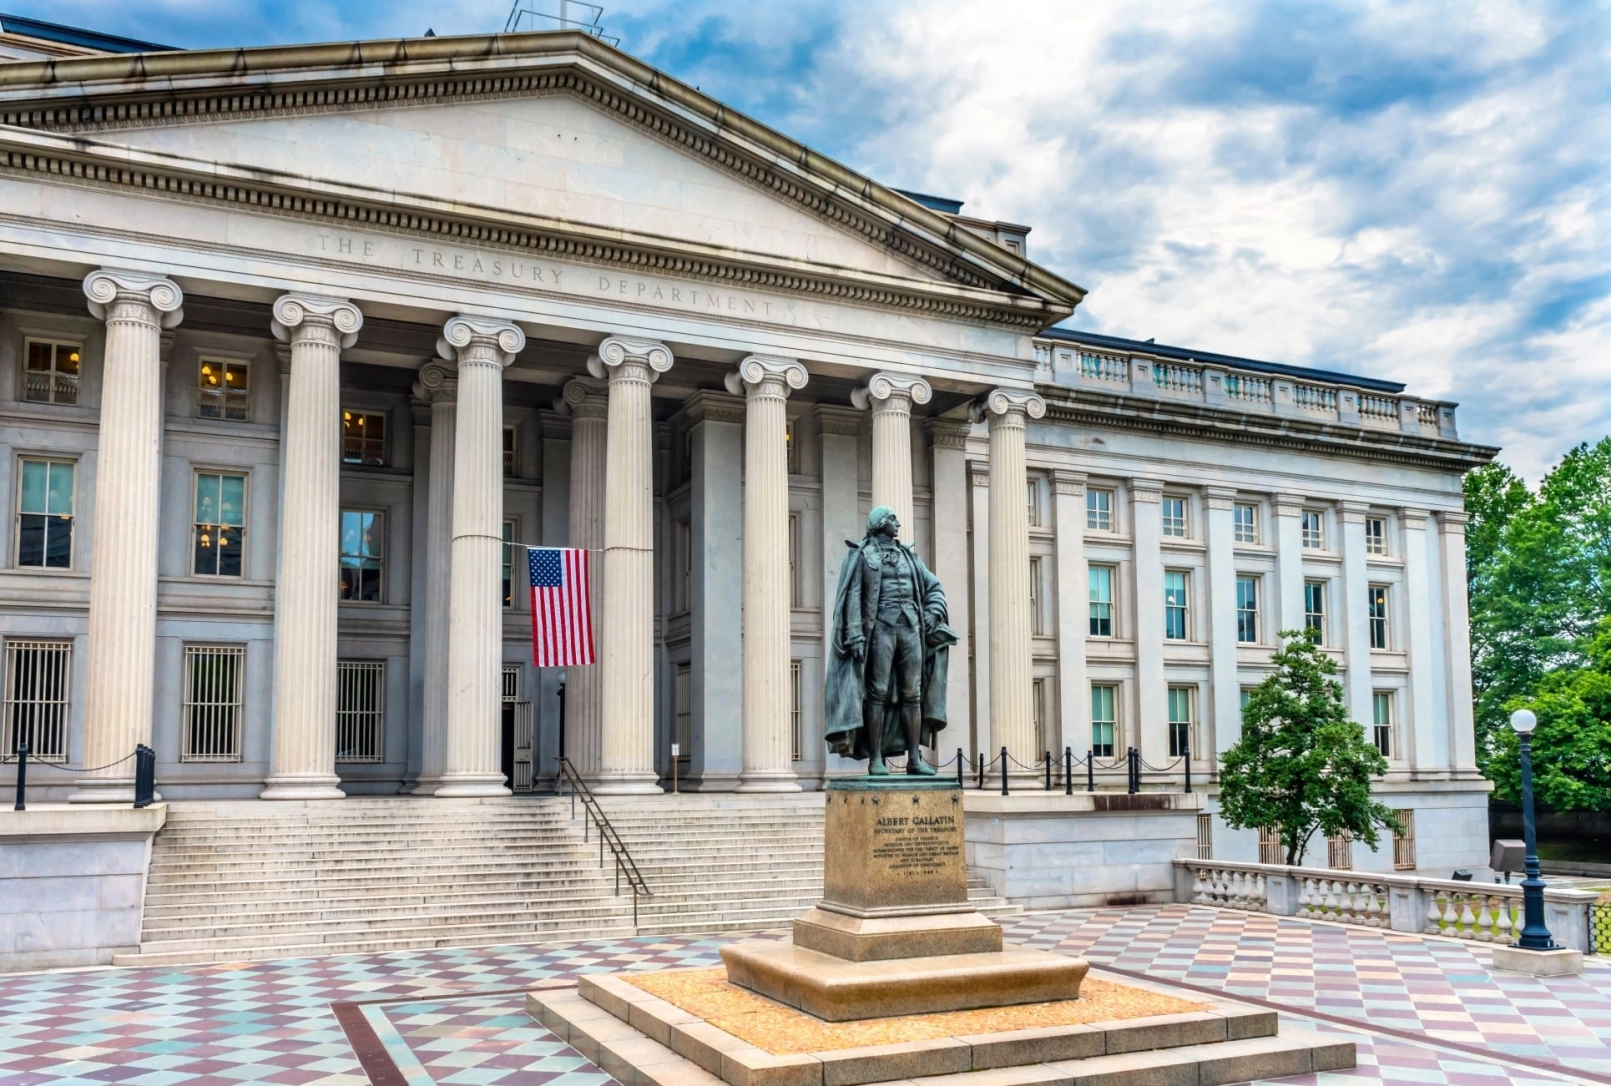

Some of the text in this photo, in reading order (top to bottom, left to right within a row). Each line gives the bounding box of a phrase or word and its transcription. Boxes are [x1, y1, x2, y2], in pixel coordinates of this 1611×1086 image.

[317, 234, 772, 316] THE TREASURY DEPARTMENT
[876, 815, 955, 826] ALBERT GALLATIN
